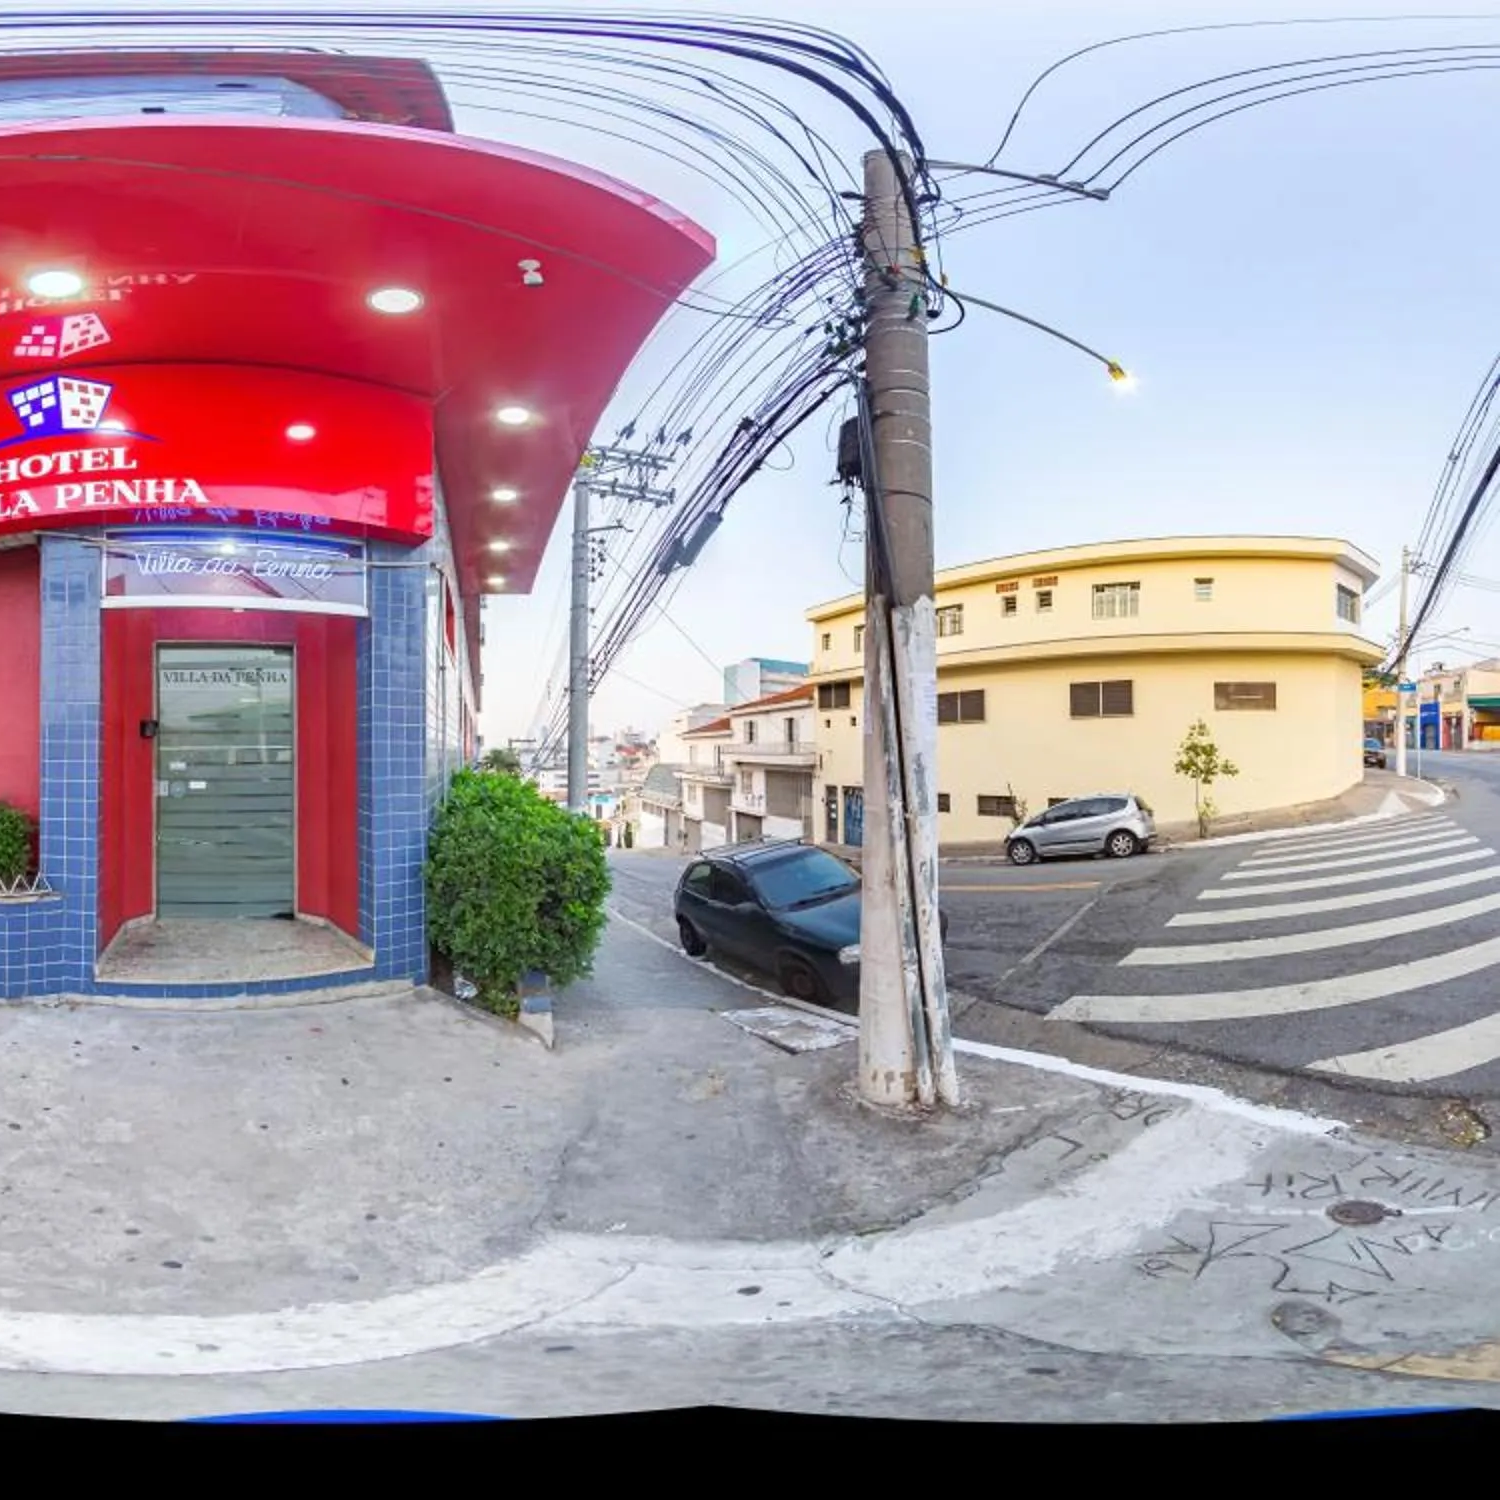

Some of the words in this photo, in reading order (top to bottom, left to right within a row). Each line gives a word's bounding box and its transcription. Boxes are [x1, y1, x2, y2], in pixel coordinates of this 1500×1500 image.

[55, 478, 209, 509] PENHA
[134, 551, 194, 576] Villa
[163, 671, 209, 684] VILLA
[236, 671, 287, 684] PENHA
